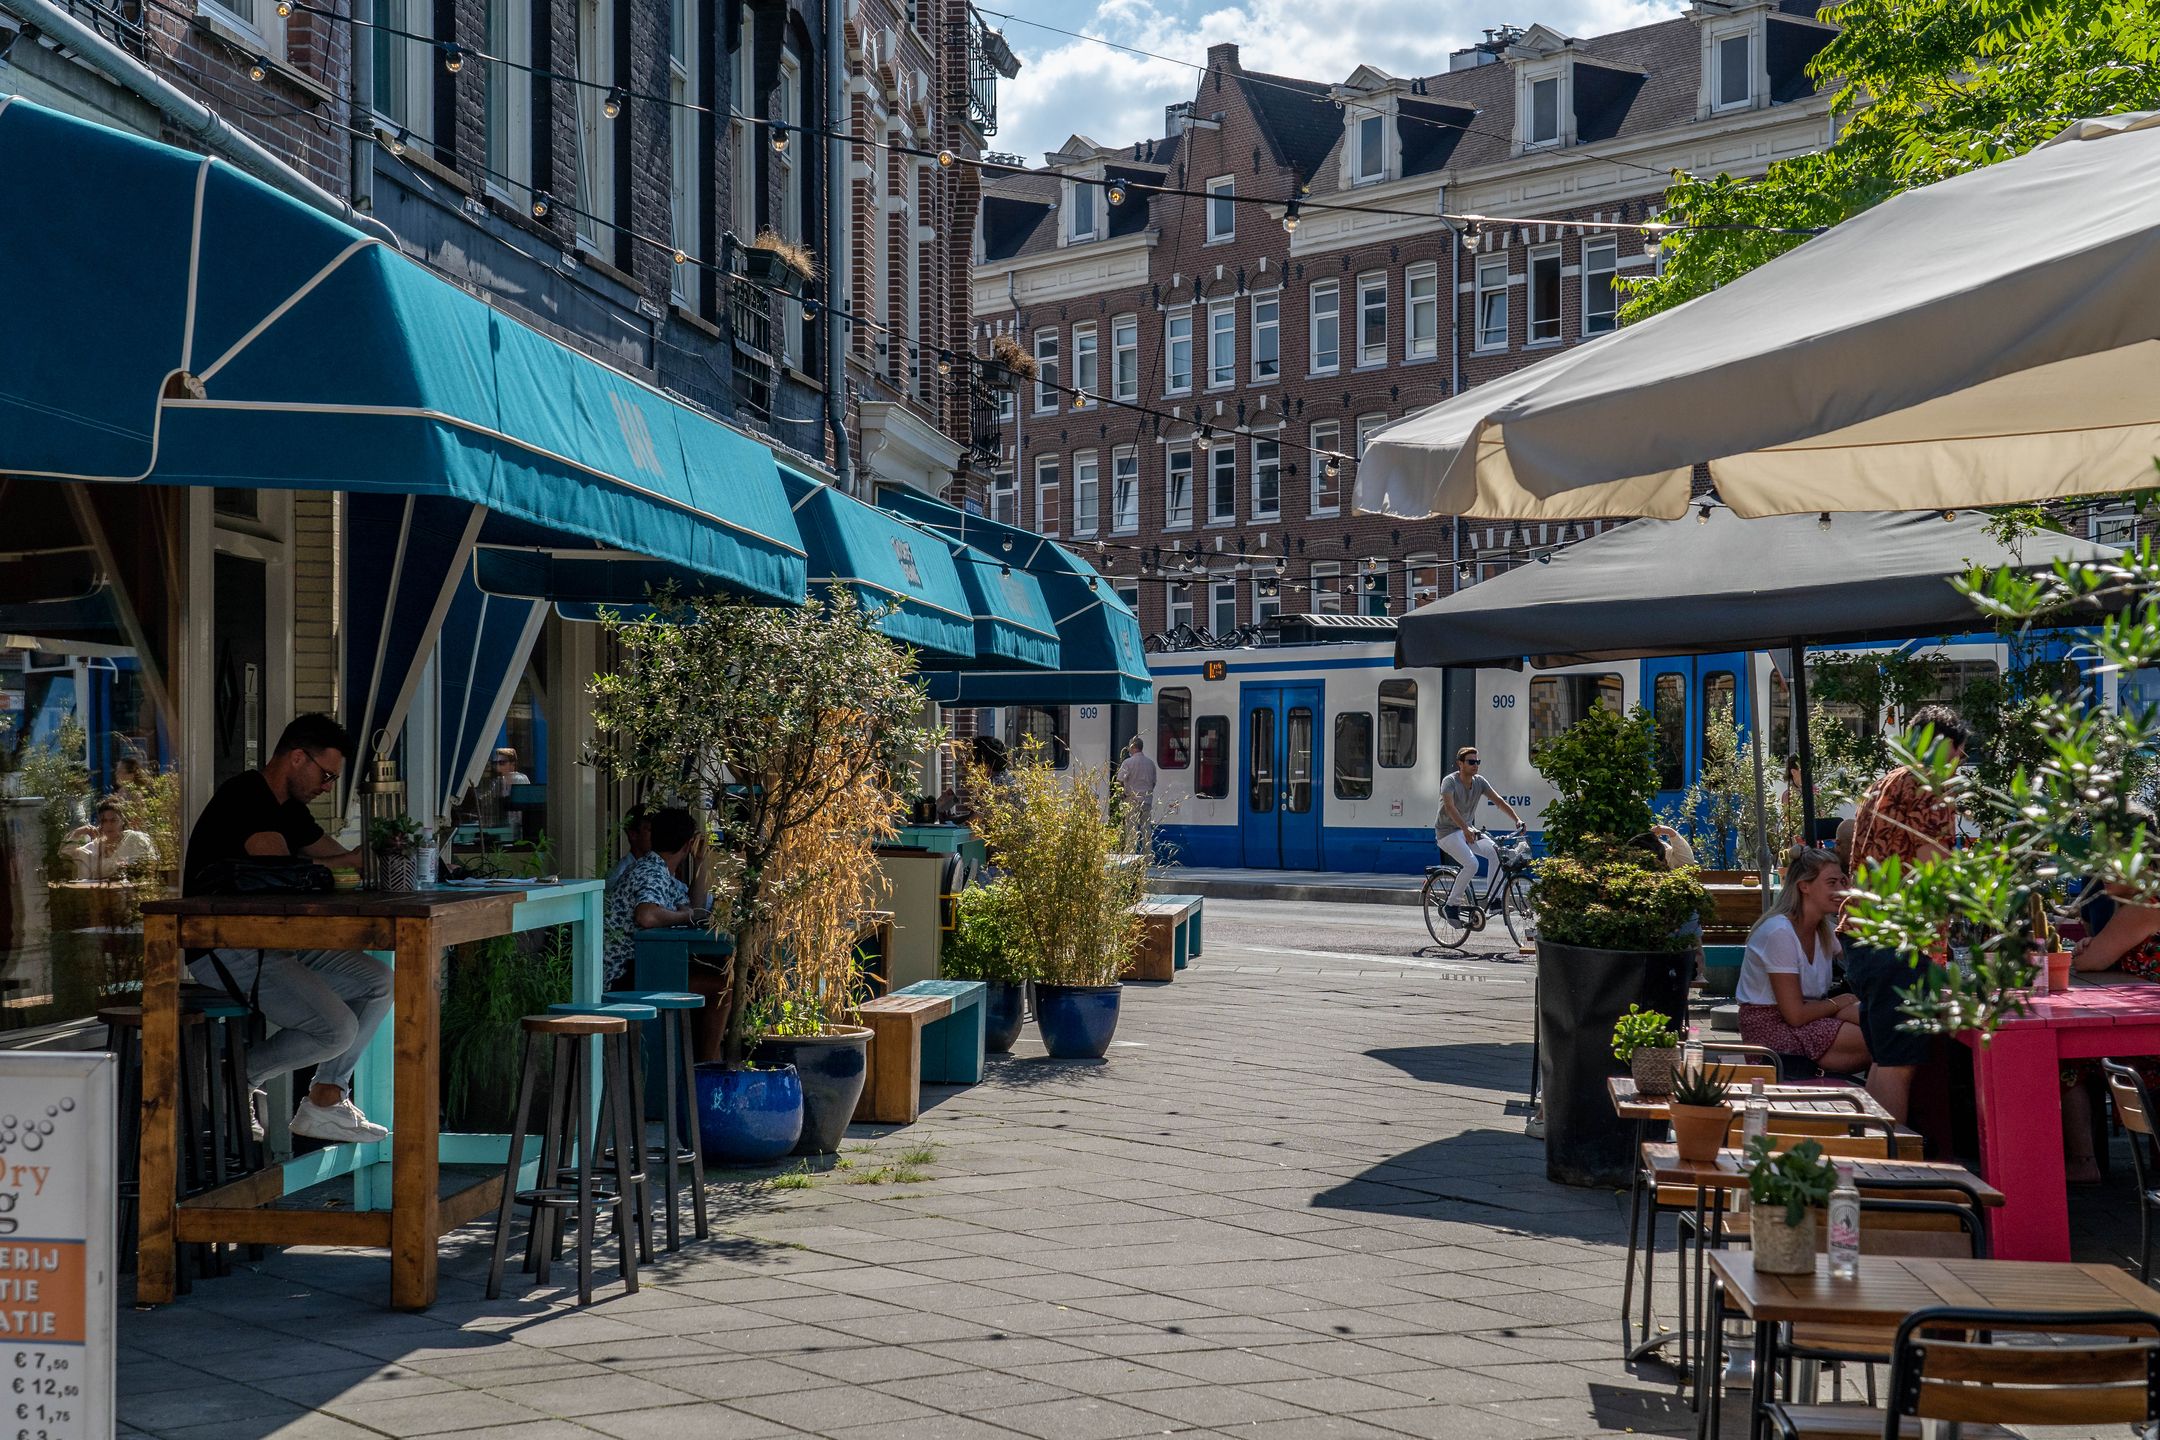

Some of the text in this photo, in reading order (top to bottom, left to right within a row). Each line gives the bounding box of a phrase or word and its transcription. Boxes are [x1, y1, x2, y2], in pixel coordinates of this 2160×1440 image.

[1492, 694, 1516, 709] 909
[1080, 706, 1098, 719] 909
[1508, 795, 1531, 807] GVB
[0, 1156, 51, 1196] ry
[0, 1247, 60, 1273] ERIJ
[34, 1352, 69, 1372] 7,50
[32, 1378, 79, 1399] 12,50
[36, 1404, 71, 1424] 1,75
